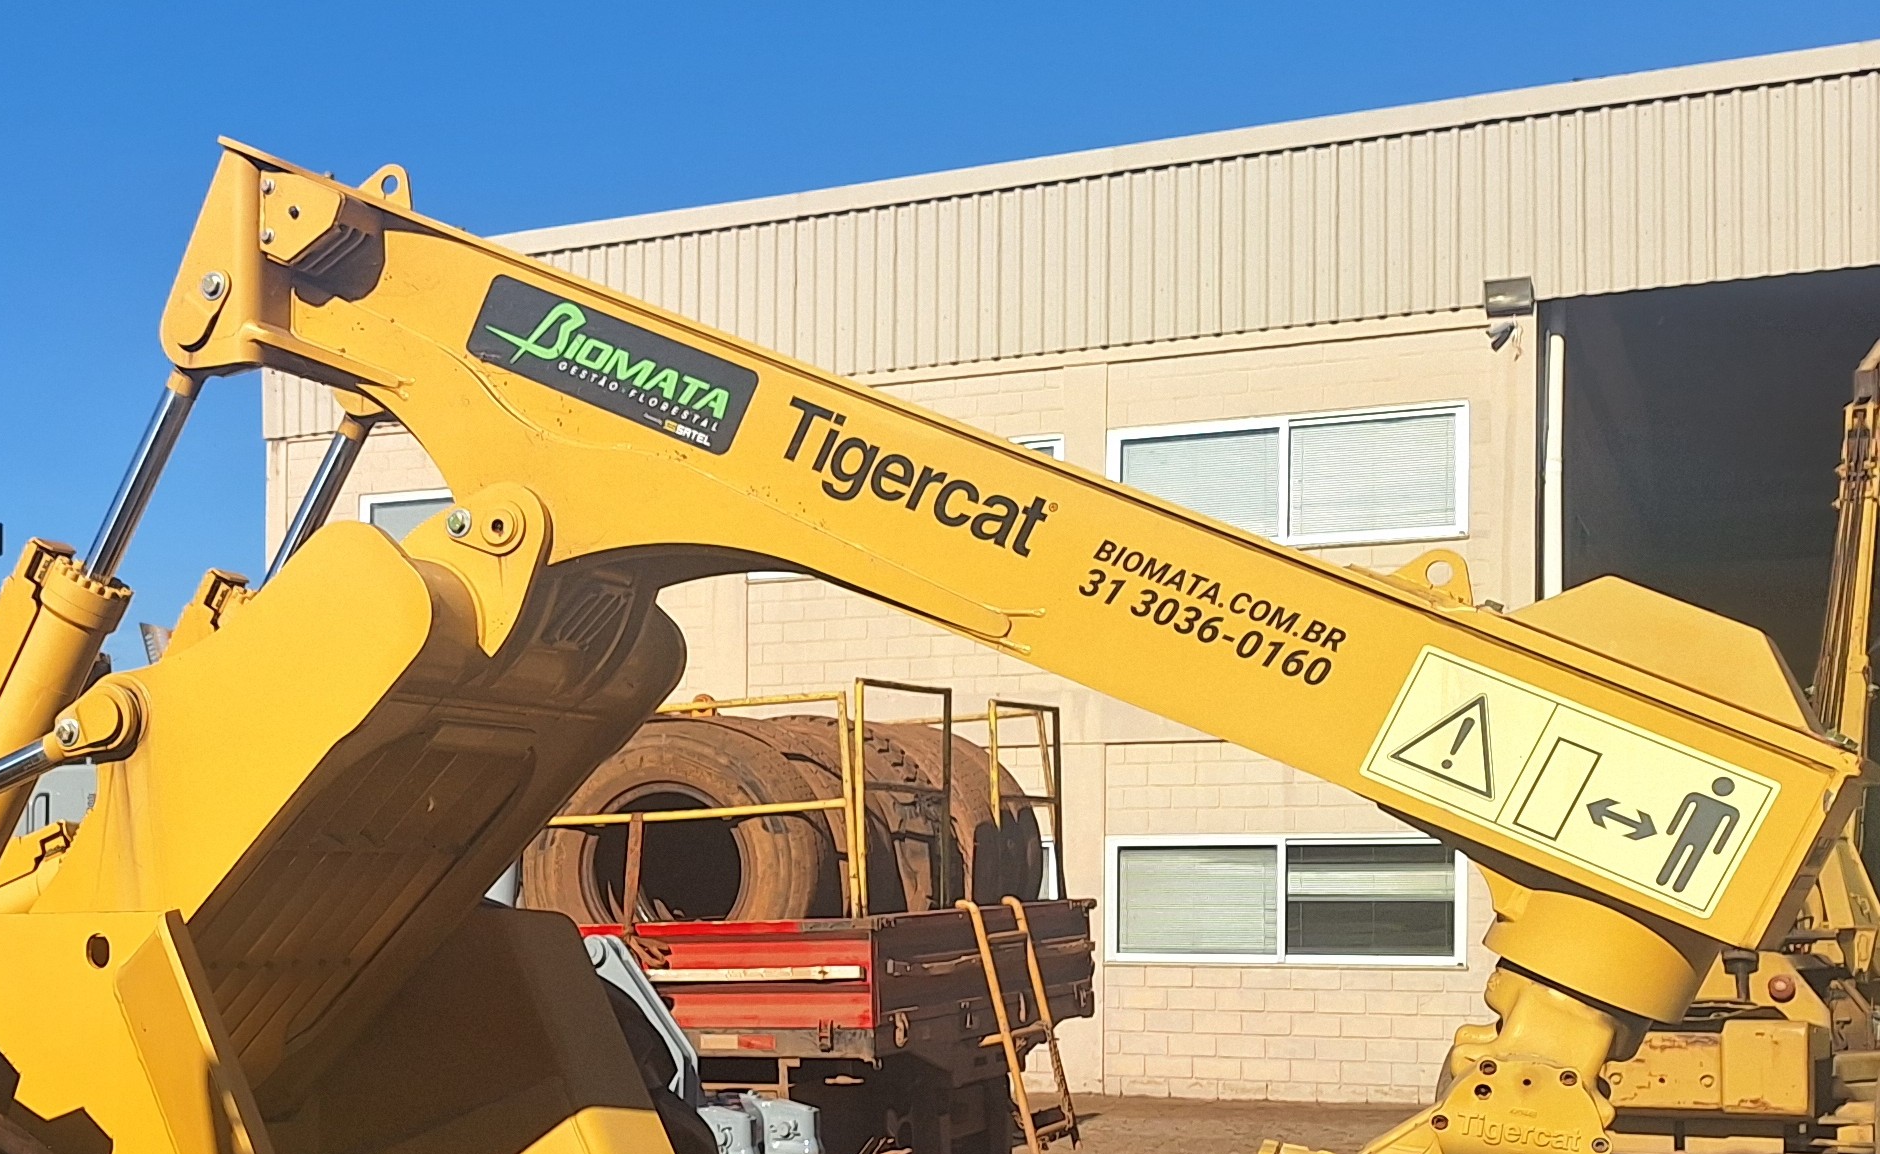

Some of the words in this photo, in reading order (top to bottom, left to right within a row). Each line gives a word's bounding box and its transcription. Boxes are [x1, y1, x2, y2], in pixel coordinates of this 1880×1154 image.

[485, 302, 730, 420] BIOMATA
[628, 388, 719, 433] FLORESTAL
[784, 395, 1048, 558] Tigercat
[1078, 568, 1127, 606] 31
[1130, 588, 1333, 686] 3036-0160
[1092, 539, 1347, 653] BIOMATA.COM.BR
[1457, 1112, 1582, 1153] Tigercat
